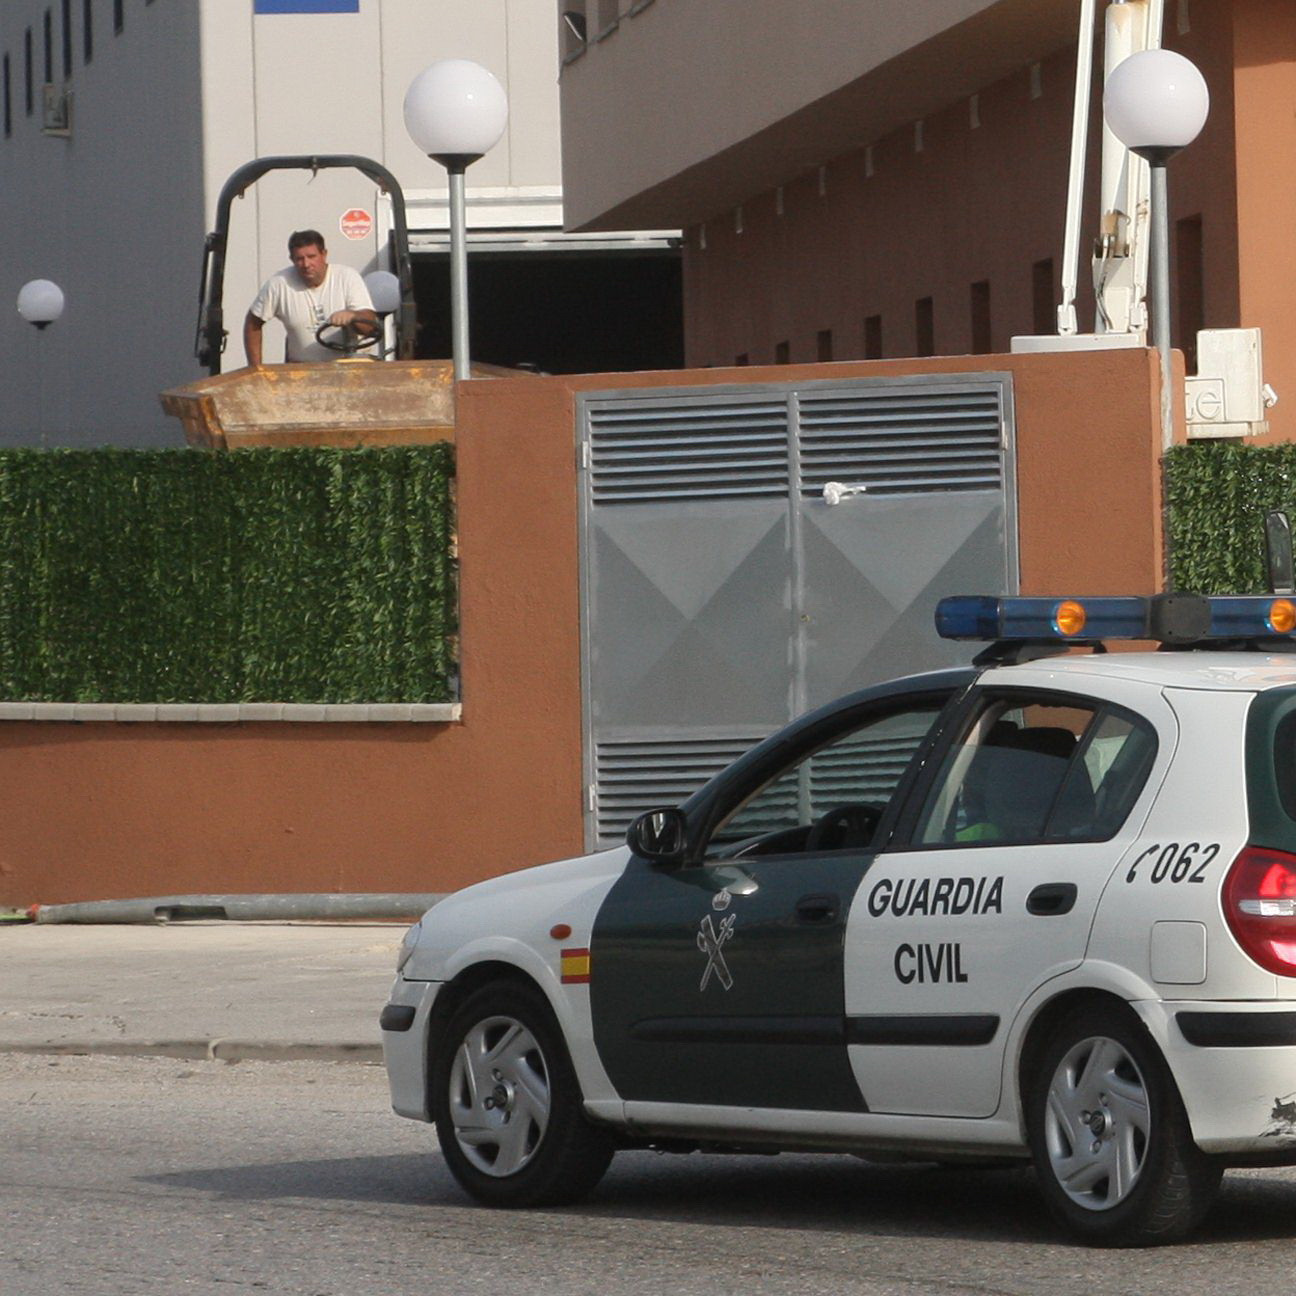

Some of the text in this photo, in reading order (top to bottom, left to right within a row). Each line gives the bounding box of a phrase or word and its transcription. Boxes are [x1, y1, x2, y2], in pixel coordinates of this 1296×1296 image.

[1150, 842, 1221, 884] 062
[867, 875, 1005, 917] GUARDIA
[893, 943, 969, 985] CIVIL
